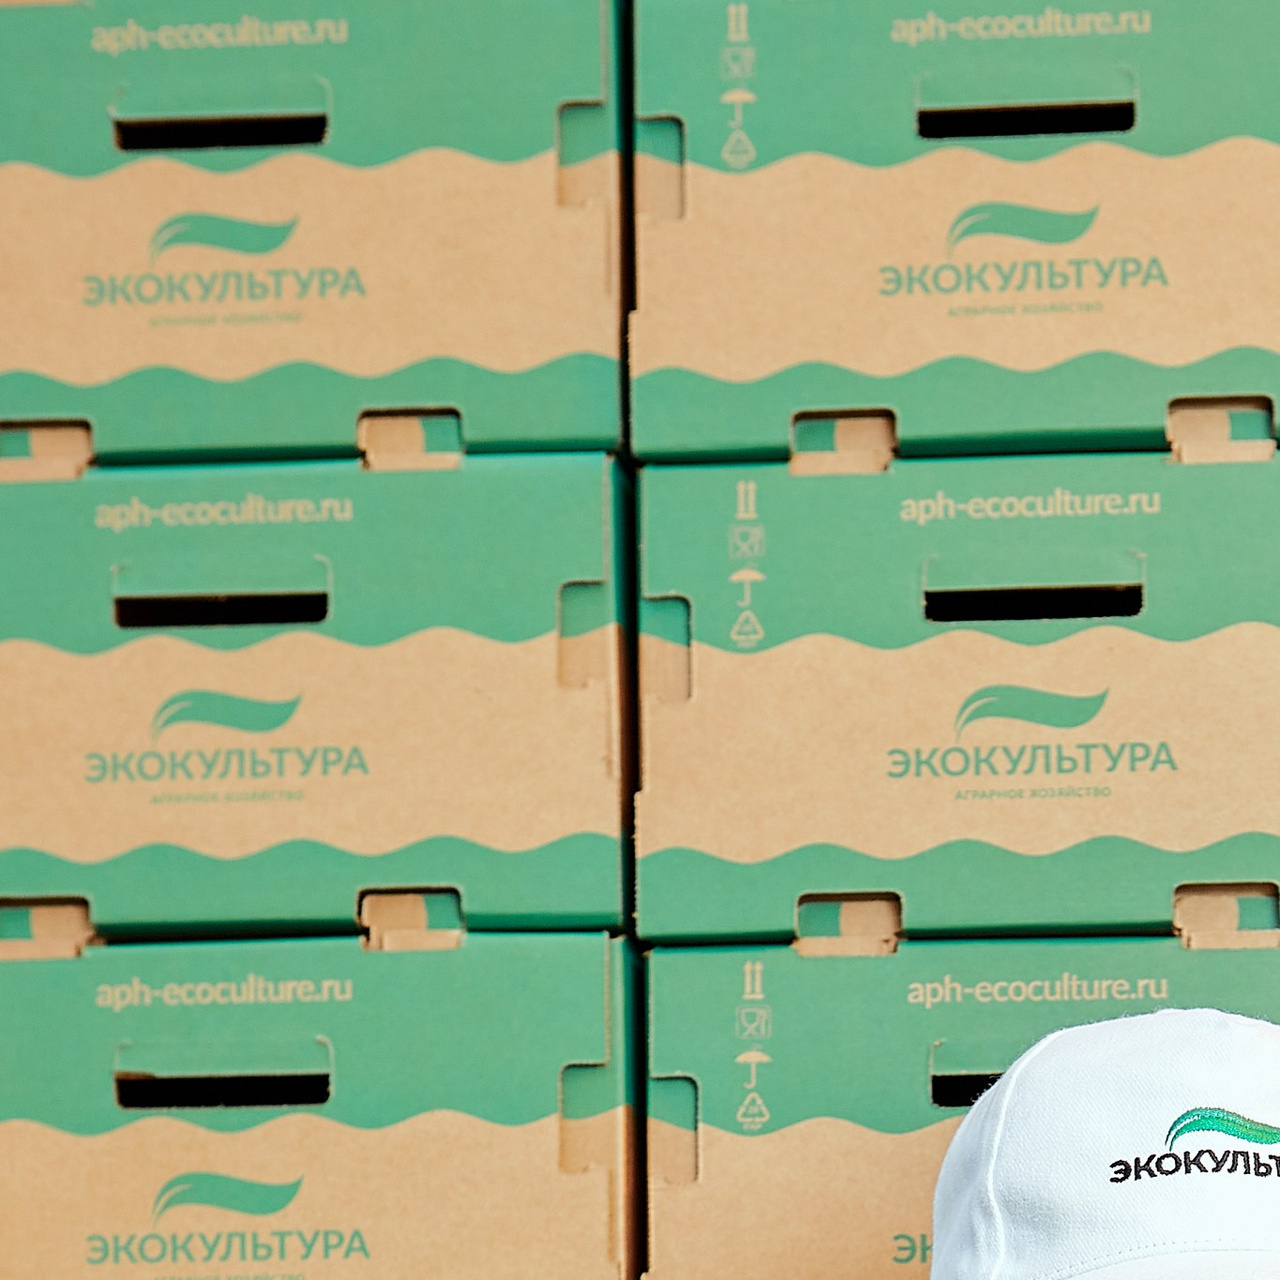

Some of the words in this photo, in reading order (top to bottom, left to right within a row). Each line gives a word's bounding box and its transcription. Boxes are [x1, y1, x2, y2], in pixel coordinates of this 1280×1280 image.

[92, 16, 348, 55] aph-ecoculture.ru
[891, 7, 1151, 46] aph-ecoculture.ru
[83, 267, 366, 307] ЭКОКУЛЬТУРА
[879, 257, 1169, 297] ЭКОКУЛЬТУРА
[96, 493, 352, 532] aph-ecoculture.ru
[901, 488, 1161, 525] aph-ecoculture.ru
[85, 746, 370, 784] ЭКОКУЛЬТУРА
[887, 742, 1178, 779] ЭКОКУЛЬТУРА
[97, 974, 352, 1011] aph-ecoculture.ru
[908, 973, 1168, 1008] aph-ecoculture.ru
[87, 1229, 371, 1265] ЭКОКУЛЬТУРА
